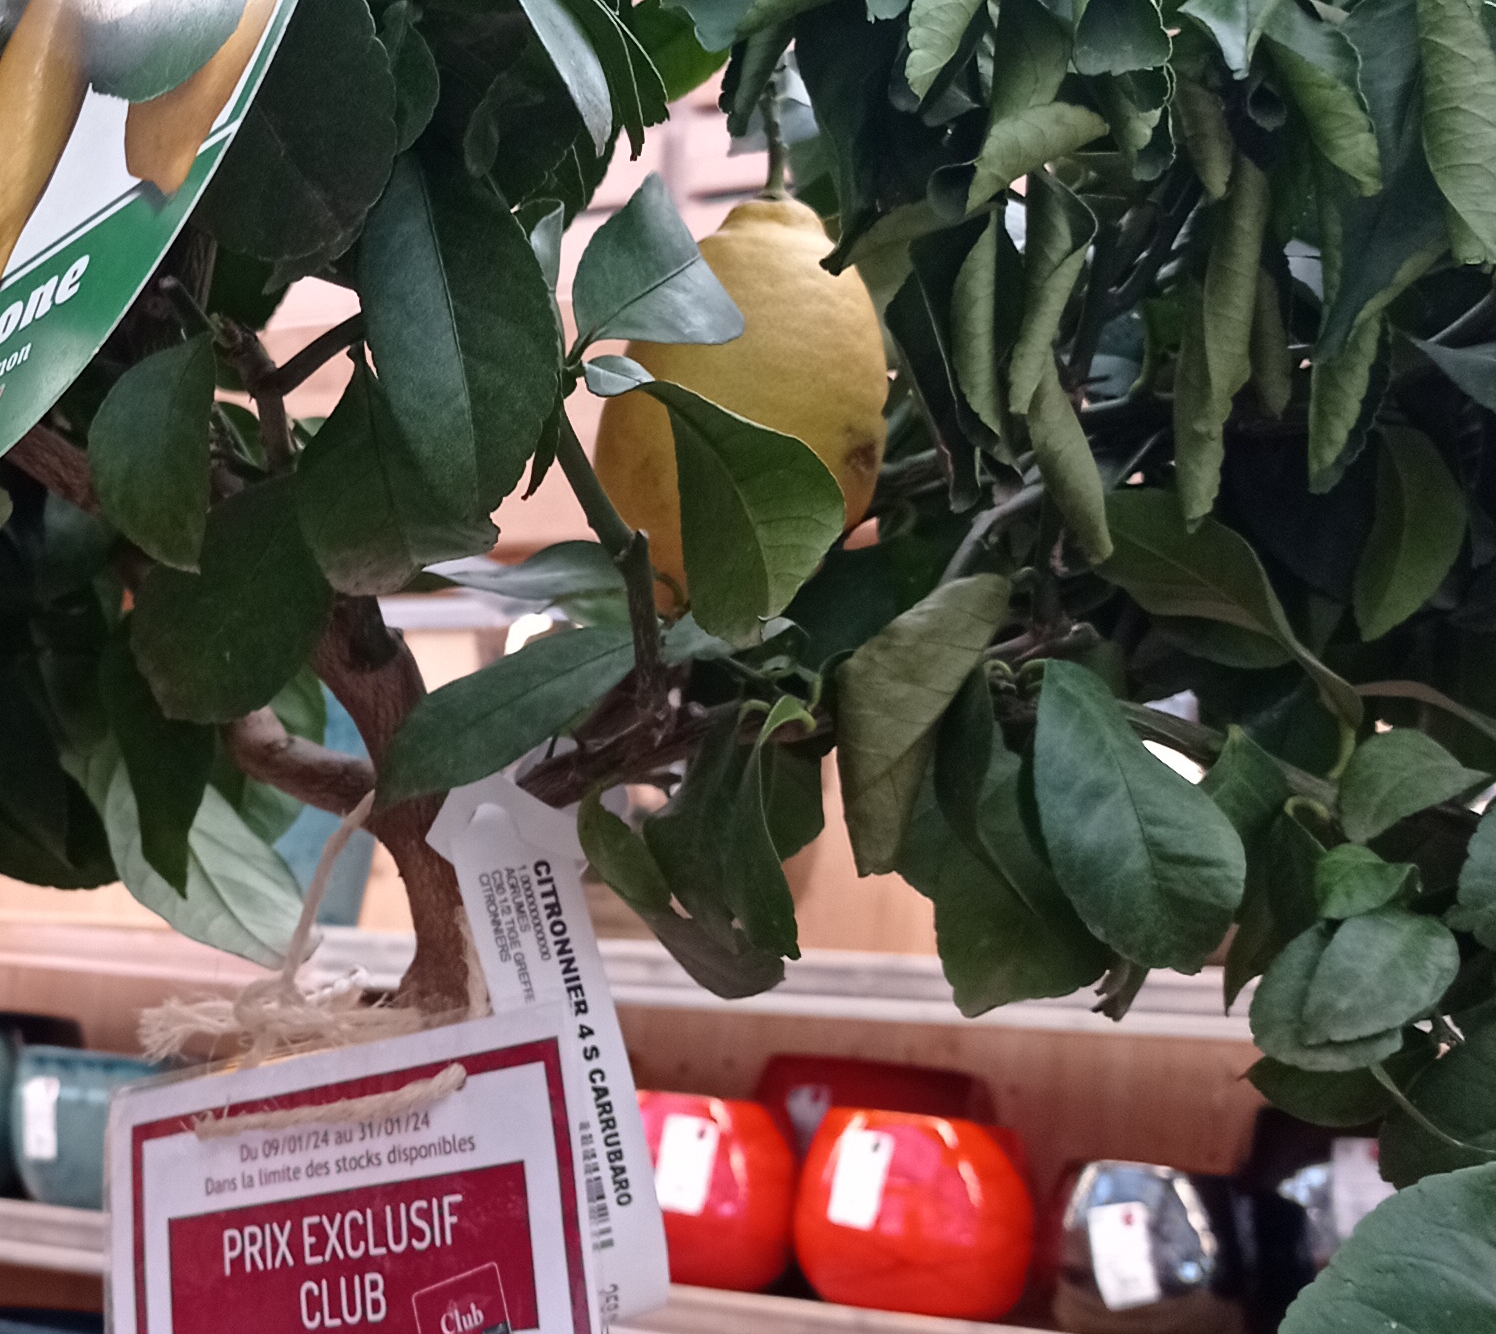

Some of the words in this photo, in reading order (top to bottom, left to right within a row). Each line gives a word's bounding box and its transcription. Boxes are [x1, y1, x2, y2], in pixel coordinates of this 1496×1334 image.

[478, 873, 512, 964] CITRONNIERS
[505, 867, 532, 934] AGRUMES
[504, 918, 522, 950] TIGE
[533, 859, 589, 1017] CITRONNIER
[578, 1023, 596, 1041] 4
[582, 1044, 601, 1063] S
[205, 1176, 238, 1197] Dans
[241, 1170, 255, 1189] la
[258, 1165, 302, 1187] limite
[305, 1159, 331, 1179] des
[335, 1149, 382, 1175] stocks
[387, 1133, 476, 1166] disponibles
[239, 1143, 259, 1163] Du
[262, 1130, 330, 1159] 09/01/24
[334, 1128, 354, 1146] au
[358, 1111, 431, 1142] 31/01/24
[588, 1067, 633, 1207] CARRUBARO
[222, 1219, 295, 1277] PRIX
[302, 1193, 463, 1266] EXCLUSIF
[299, 1271, 387, 1330] CLUB
